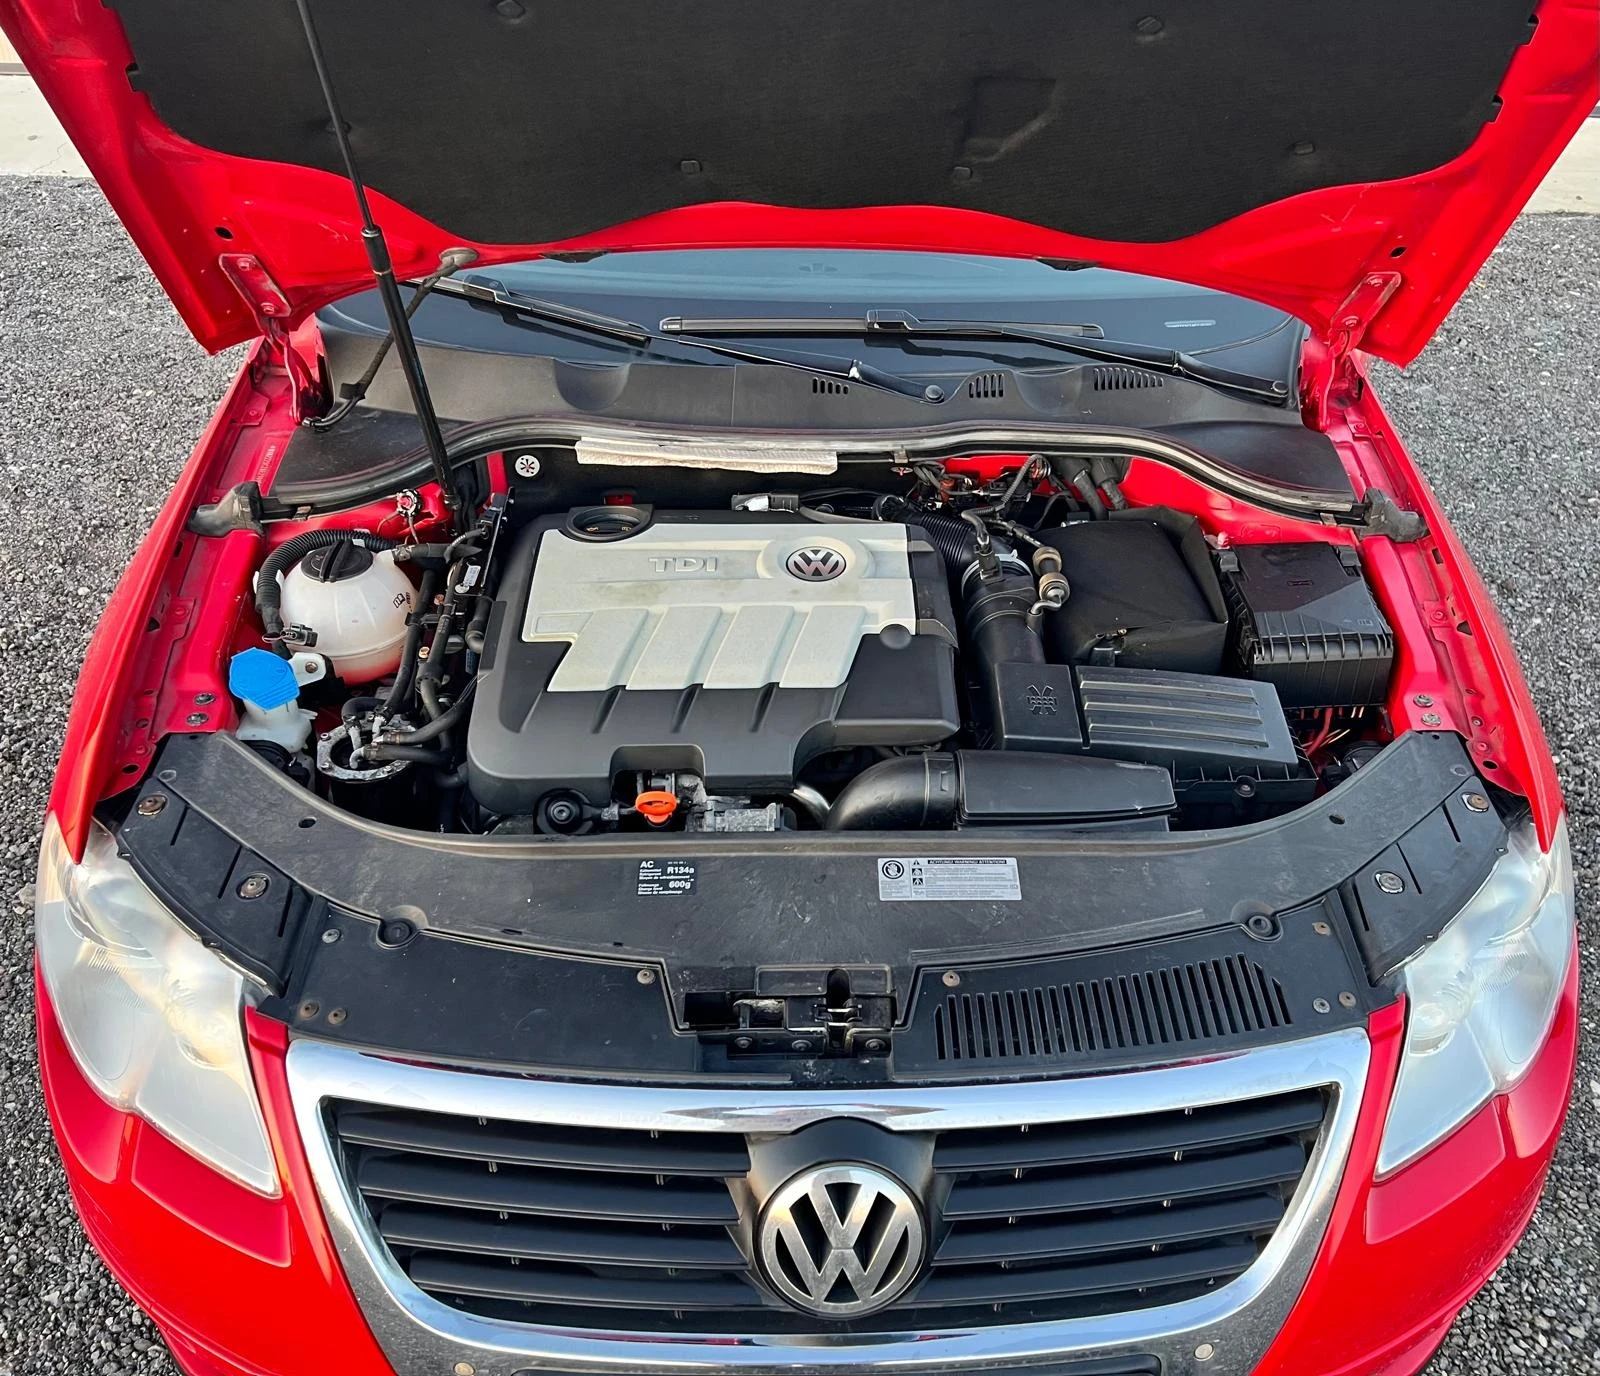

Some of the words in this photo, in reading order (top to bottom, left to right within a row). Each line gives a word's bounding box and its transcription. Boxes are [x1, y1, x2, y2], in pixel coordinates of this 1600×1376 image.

[649, 557, 717, 572] TDI
[786, 546, 846, 581] VW
[667, 866, 695, 874] R134a
[669, 881, 691, 889] 600g
[761, 1165, 923, 1314] VW
